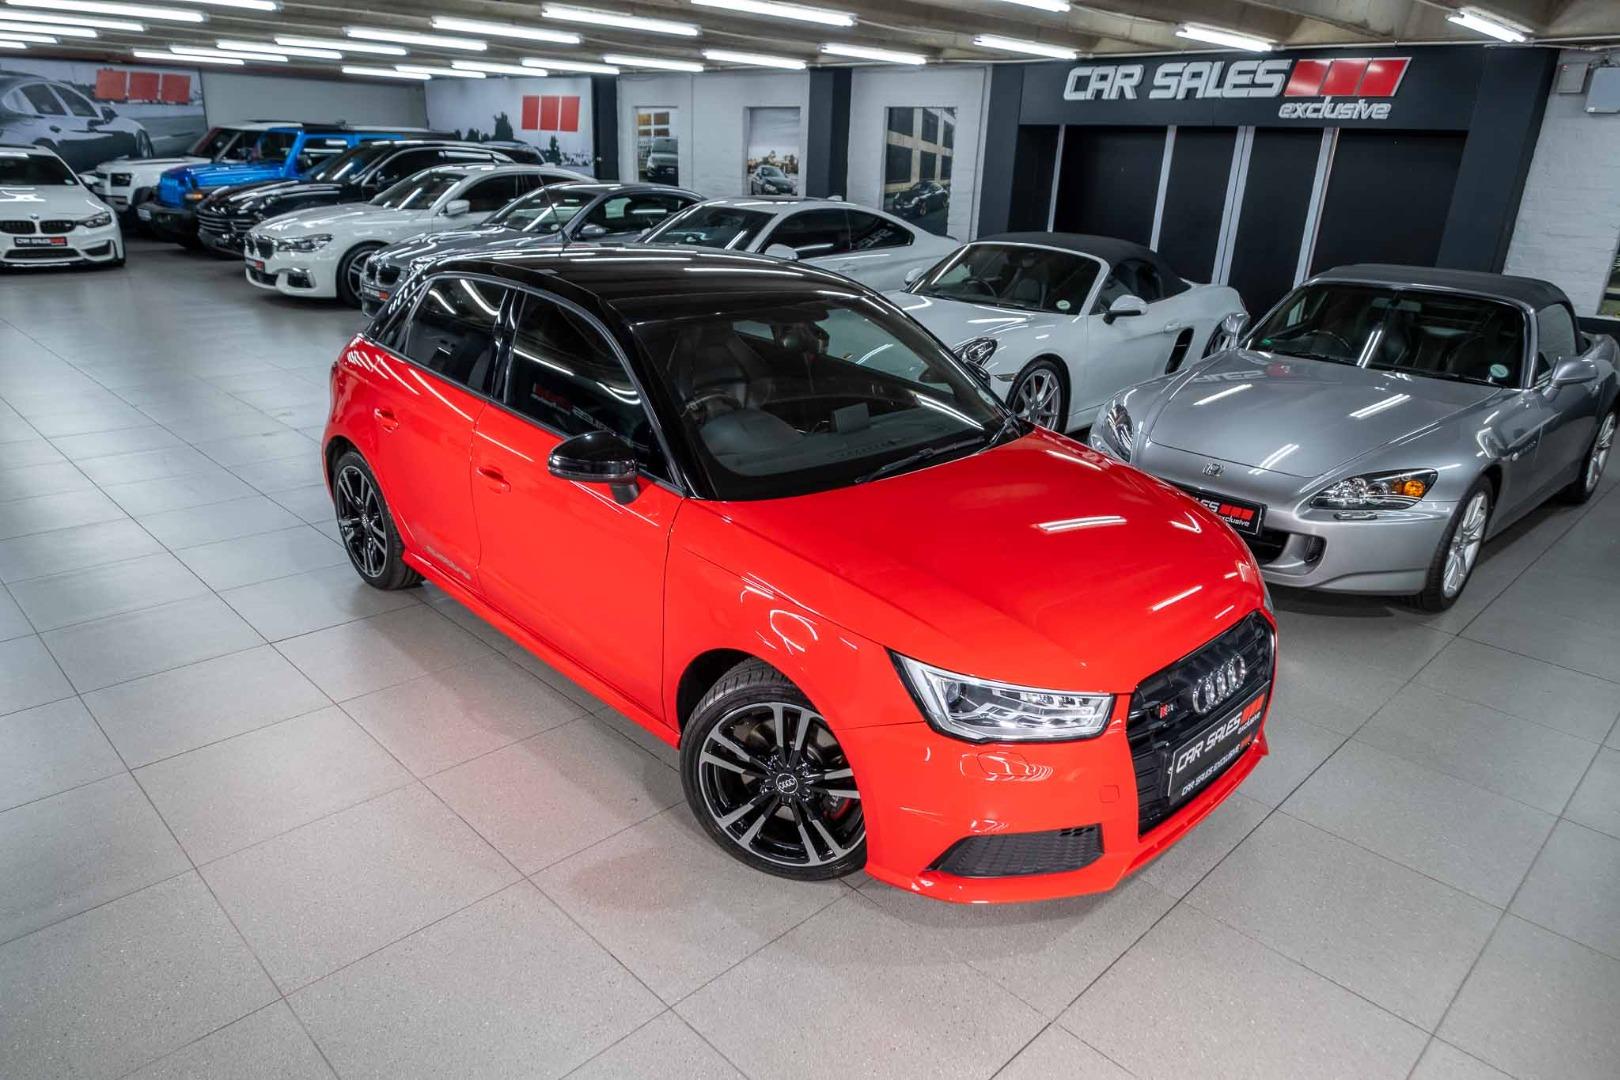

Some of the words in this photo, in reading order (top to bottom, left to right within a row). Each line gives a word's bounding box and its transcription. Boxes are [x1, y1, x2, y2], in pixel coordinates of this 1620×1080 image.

[1063, 64, 1144, 100] CAR
[1149, 59, 1292, 99] SALES
[1278, 95, 1392, 119] exclusive
[1176, 740, 1204, 773] CAR
[1204, 711, 1243, 753] SALES
